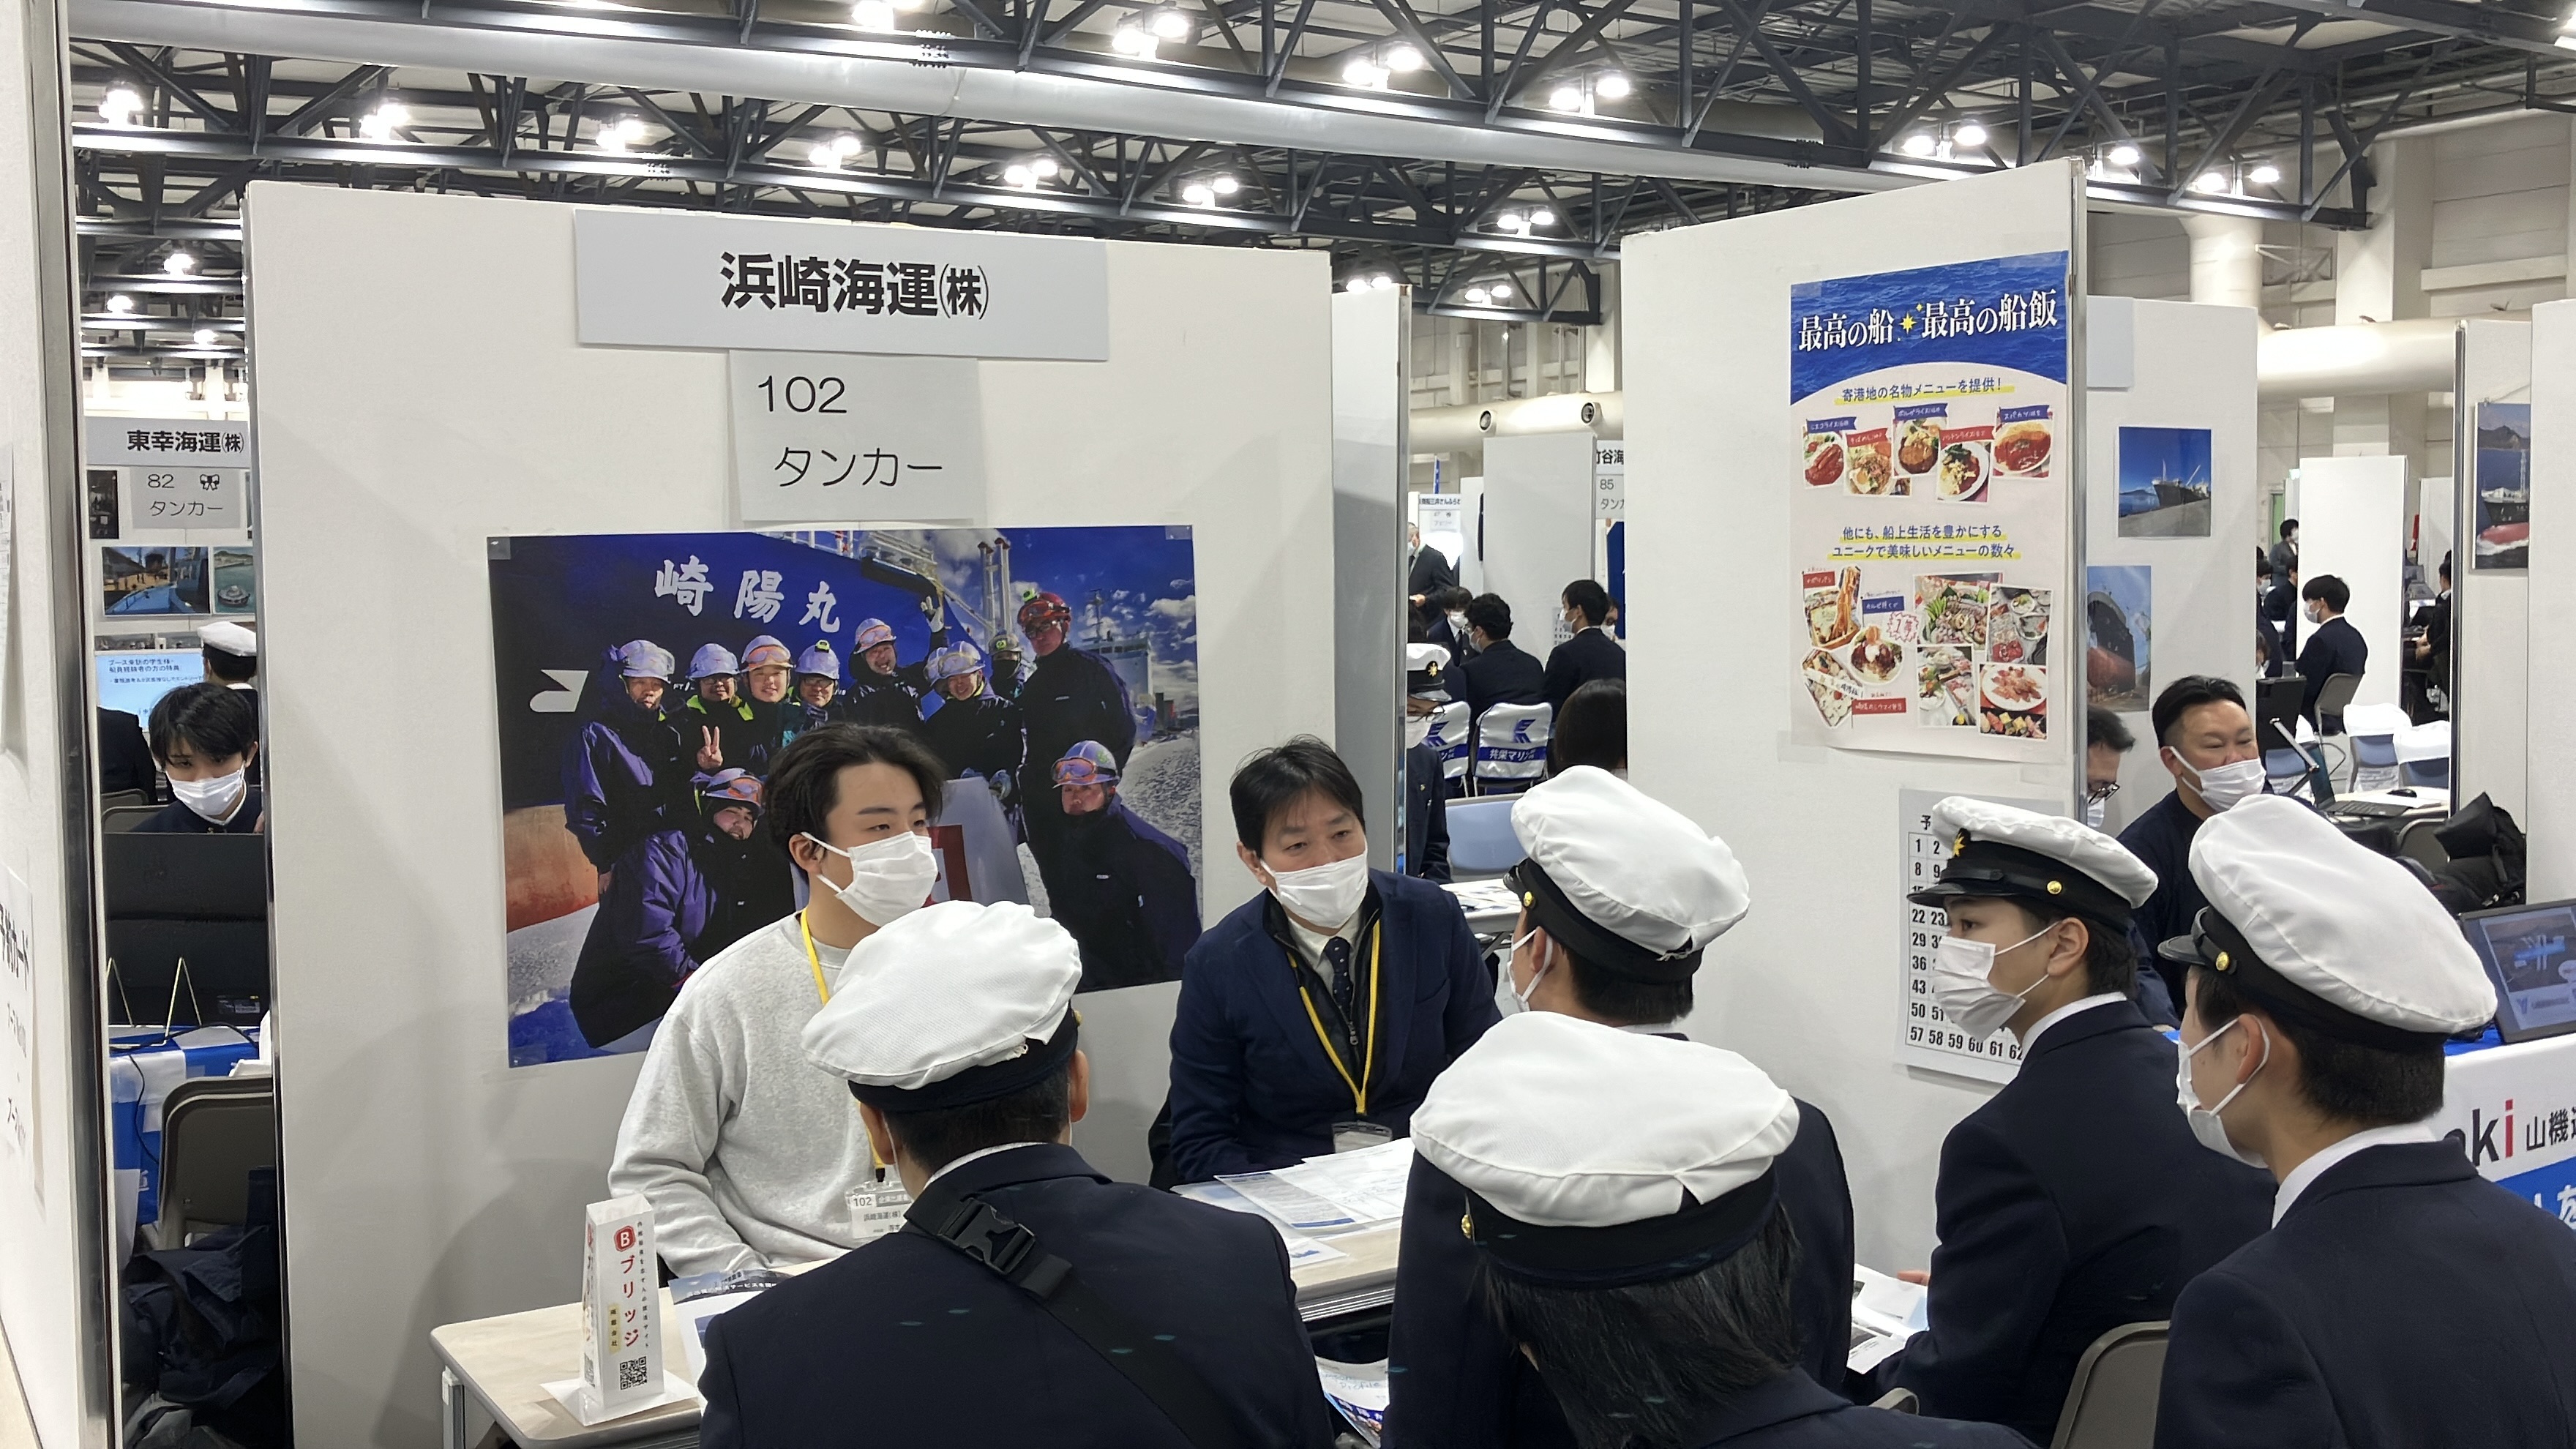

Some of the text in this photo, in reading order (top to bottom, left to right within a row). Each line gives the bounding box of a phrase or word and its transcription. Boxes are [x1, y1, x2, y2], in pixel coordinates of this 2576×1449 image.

[720, 252, 989, 320] 浜崎海運㈱
[1798, 288, 2059, 353] 最高の船 最高の船飯
[758, 375, 847, 413] 102
[1841, 377, 2003, 402] 寄港地の名物メニューを提供！
[774, 447, 943, 487] タンカー
[147, 473, 175, 489] 82
[1599, 479, 1614, 490] 85
[150, 501, 223, 516] タンカー
[1842, 524, 2002, 541] 他にも、船上生活を豊かにする
[1832, 543, 2015, 559] ユニークで美味しいメニューの数々
[654, 555, 840, 633] 崎陽丸
[1920, 815, 1931, 831] 予
[1915, 839, 1940, 855] 1 2
[1914, 862, 1940, 878] 8 9
[1912, 909, 1945, 926] 22 23
[1912, 932, 1926, 947] 29
[1912, 956, 1927, 971] 36
[1912, 979, 1926, 994] 43
[1911, 1003, 1944, 1022] 50 51
[1910, 1027, 1924, 1042] 57
[1928, 1030, 1944, 1046] 58
[1947, 1033, 1963, 1049] 59
[1989, 1041, 2004, 1057] 61
[2526, 1106, 2576, 1151] 山機
[853, 1197, 872, 1207] 102
[620, 1231, 630, 1247] B
[621, 1255, 639, 1347] ブリッジ
